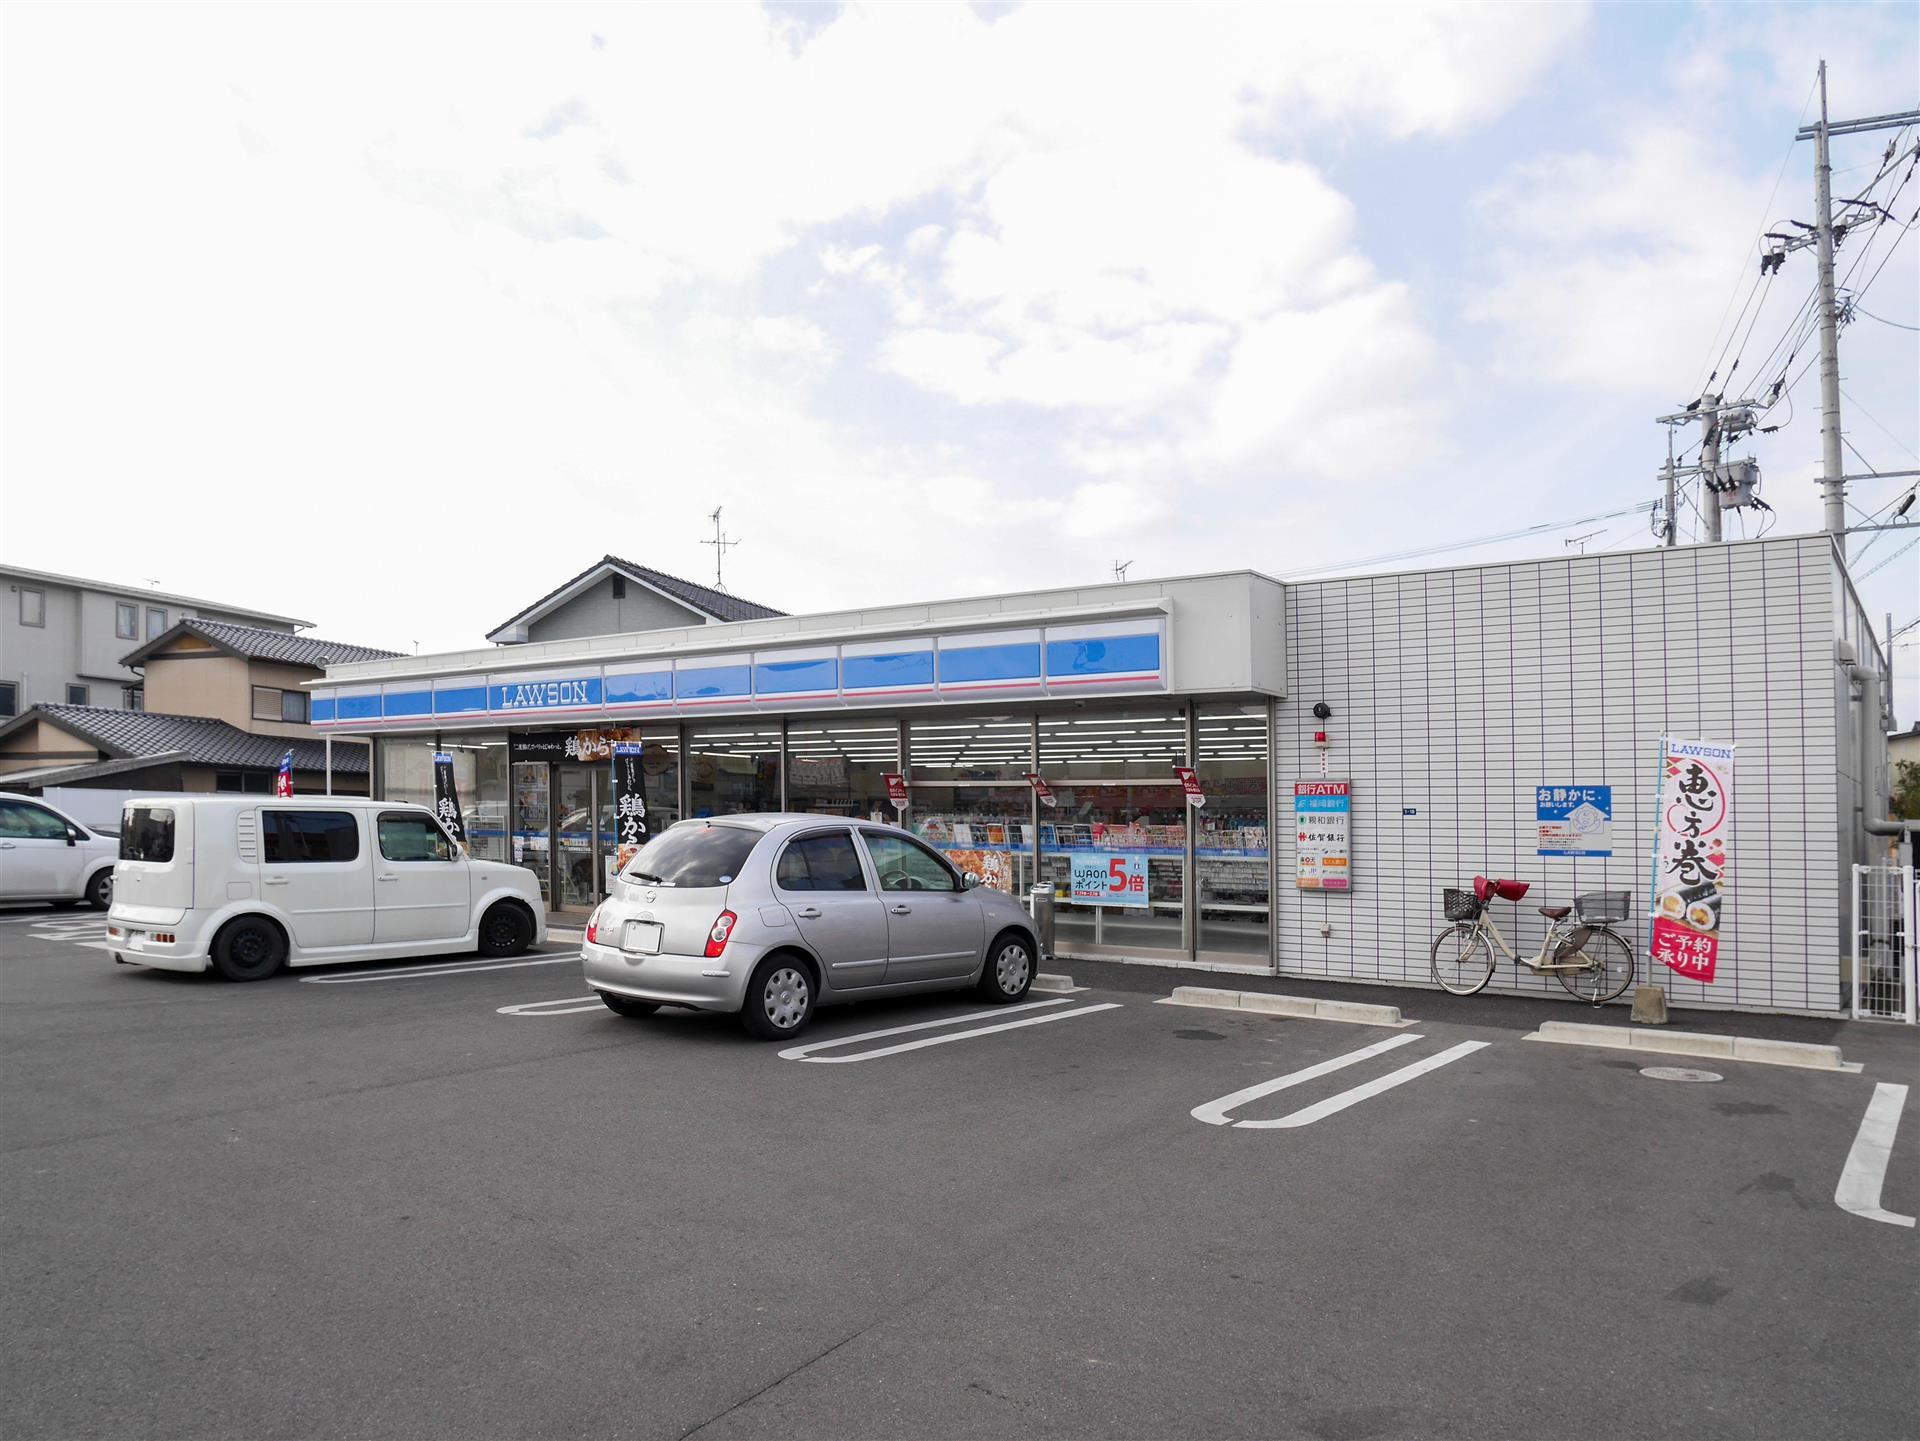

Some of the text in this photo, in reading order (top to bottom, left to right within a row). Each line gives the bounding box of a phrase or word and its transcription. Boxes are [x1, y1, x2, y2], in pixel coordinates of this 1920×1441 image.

[502, 681, 588, 708] LAWSON
[565, 736, 610, 757] 鶏から
[1671, 743, 1731, 759] LAWSON
[1298, 784, 1345, 795] 銀行ATM
[1538, 788, 1595, 801] お静かに
[1310, 799, 1344, 808] 福岡銀行
[438, 797, 460, 841] 鶏か
[1309, 816, 1344, 825] 親和銀行
[1666, 763, 1718, 886] 恵方巻
[1308, 832, 1344, 842] 佐賀銀行
[1075, 878, 1107, 890] ポイント
[1658, 931, 1712, 953] ご予約
[1657, 948, 1709, 971] 承り中
